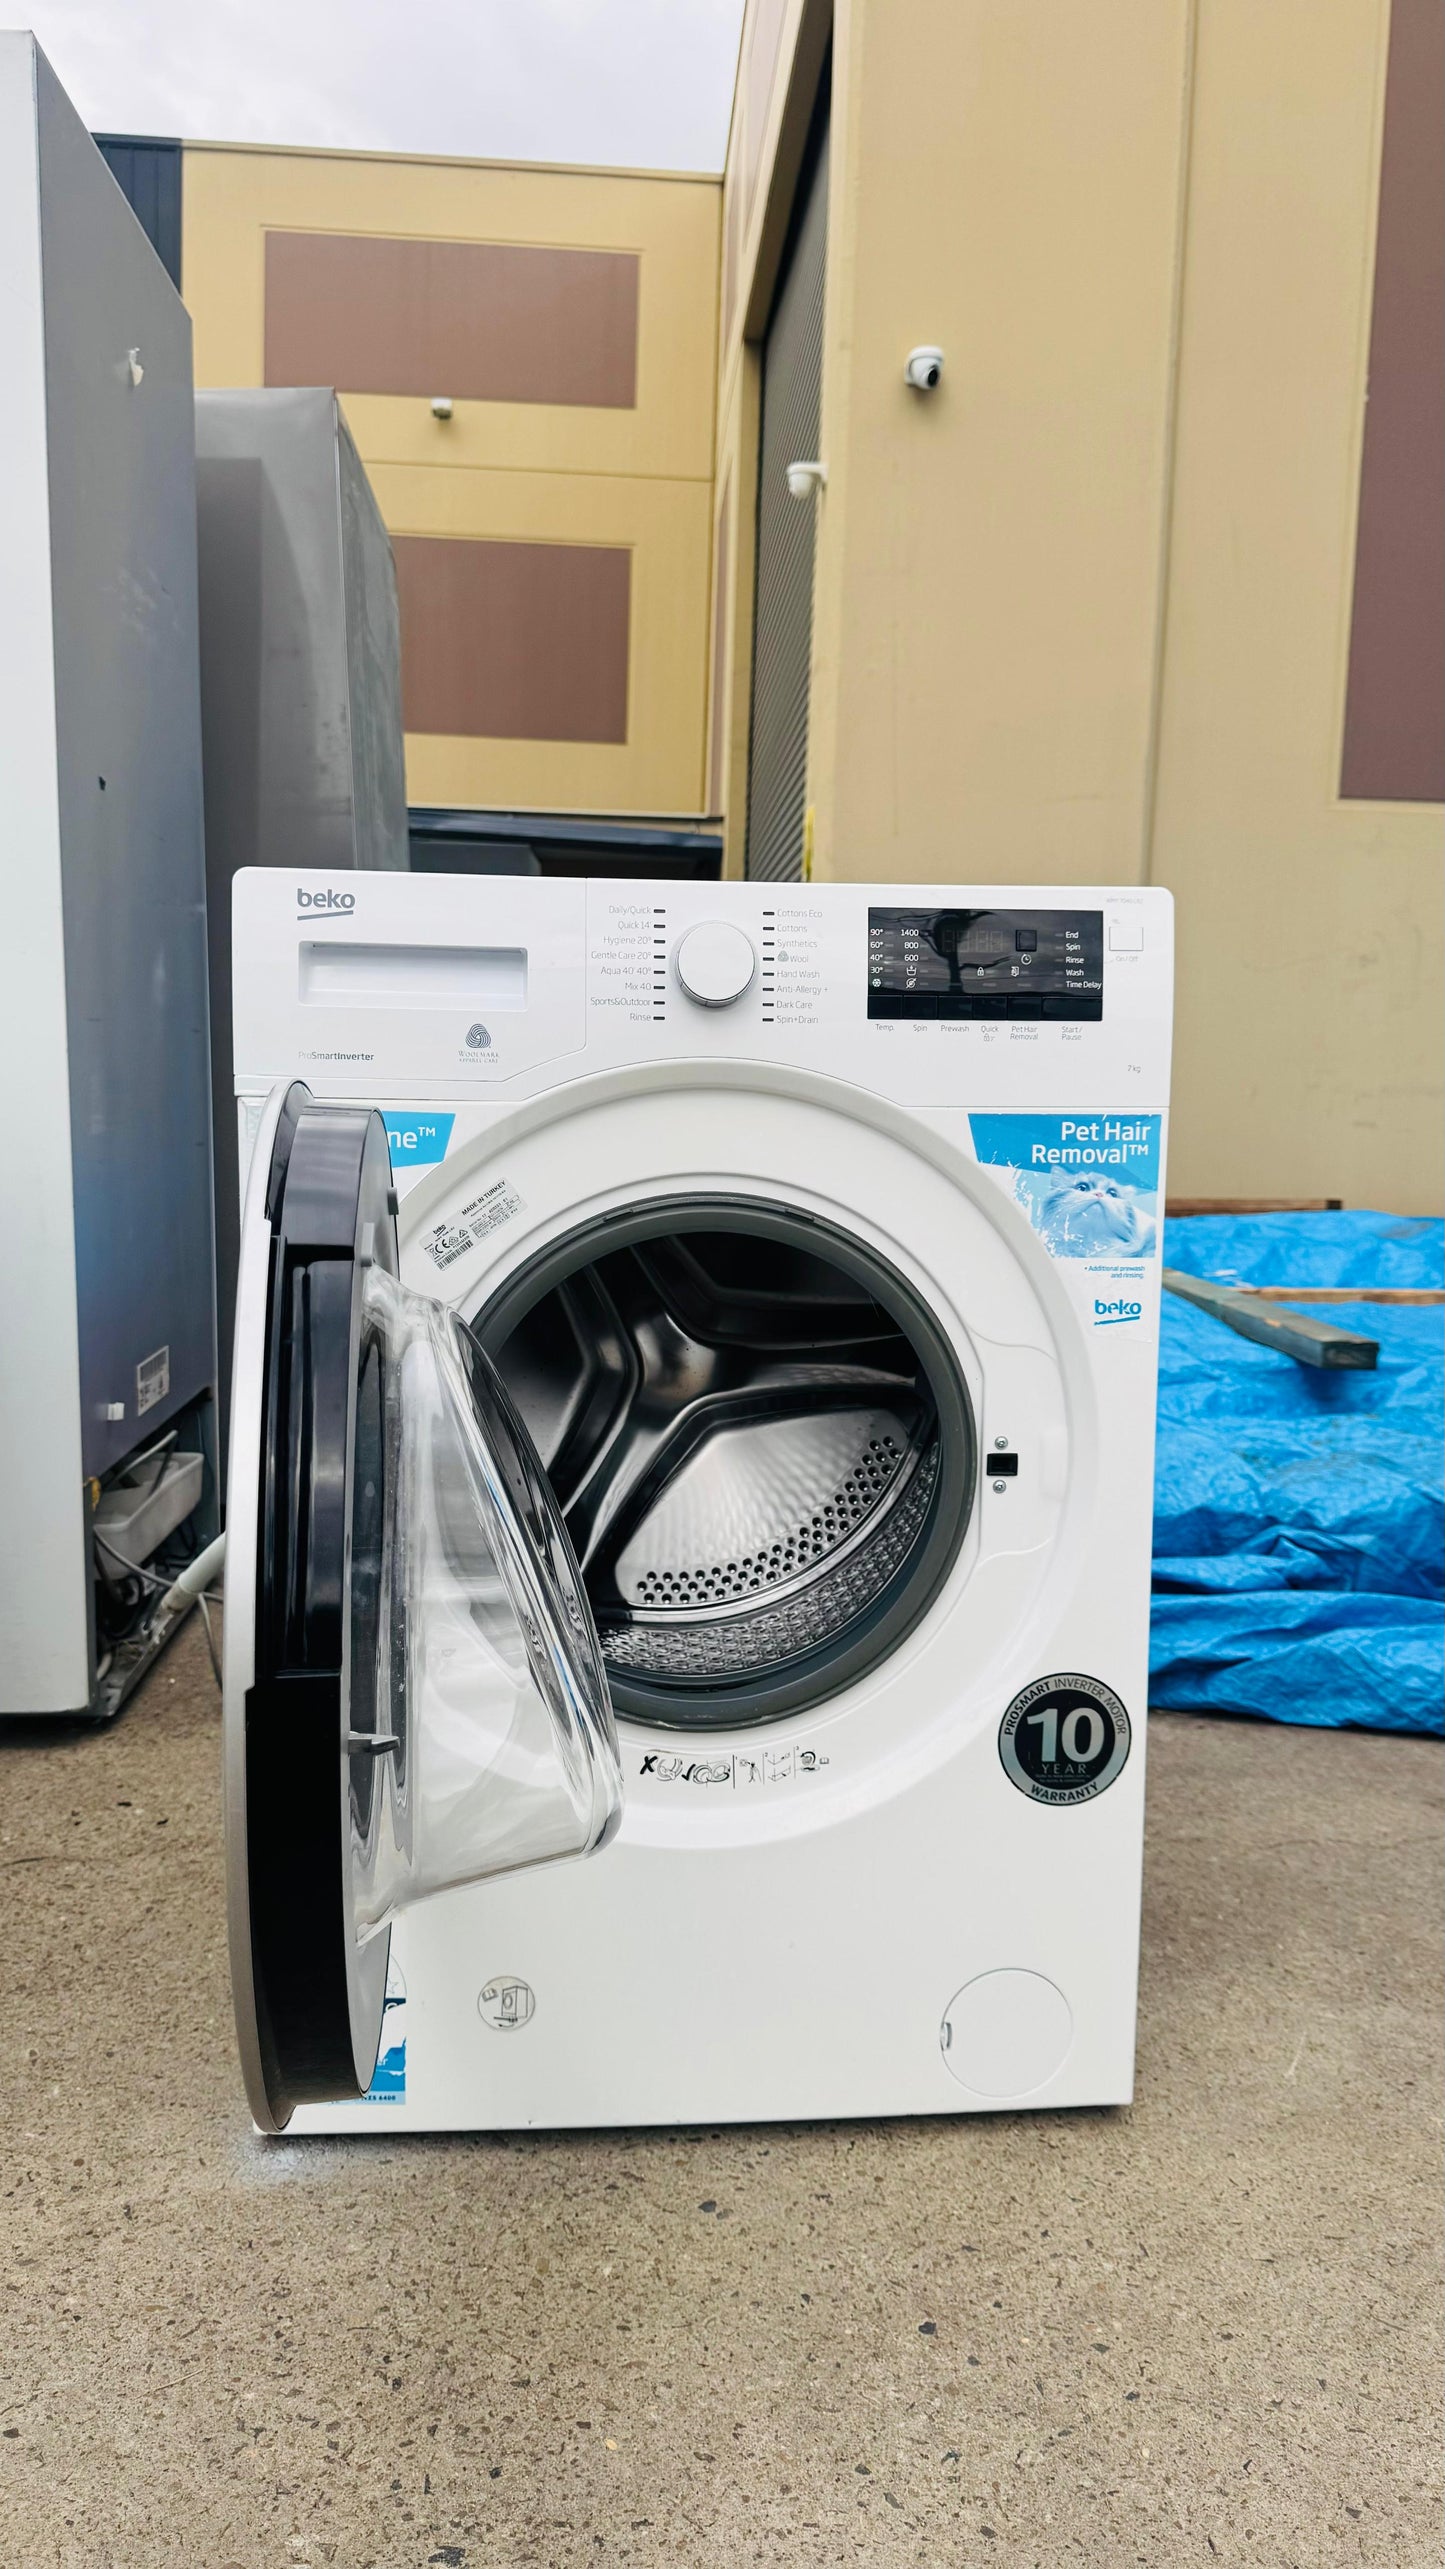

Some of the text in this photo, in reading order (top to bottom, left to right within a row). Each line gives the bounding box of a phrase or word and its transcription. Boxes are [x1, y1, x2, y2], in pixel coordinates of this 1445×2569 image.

[297, 888, 355, 908] beko
[609, 906, 651, 915] Daily/Quick
[777, 910, 823, 918] Cottons Eco
[618, 921, 639, 930] Quick
[777, 925, 808, 933] Cottons
[604, 937, 636, 946] Hygiene
[777, 940, 817, 949] Synthetics
[1066, 943, 1080, 951] Spin
[1066, 956, 1084, 964] Rinse
[601, 967, 621, 976] Aqua
[777, 970, 820, 978] Hand Wash
[777, 985, 821, 995] Anti-Allergy
[1083, 981, 1101, 990] Delay
[591, 998, 651, 1007] Sports&Outdoor
[777, 1001, 794, 1009] Dark
[630, 1013, 651, 1021] Rinse
[913, 1024, 927, 1032] Spin
[1010, 1033, 1038, 1041] Removal
[1062, 1033, 1082, 1041] Pause
[1061, 1121, 1151, 1141] Pet Hair
[462, 1180, 506, 1215] MADE IN TURKEY
[1094, 1299, 1142, 1315] beko
[1004, 1677, 1127, 1735] PROSMART INVERTER MOTOR
[1027, 1707, 1105, 1763] 10
[1042, 1764, 1088, 1774] YEAR
[1031, 1781, 1098, 1802] WARRANTY
